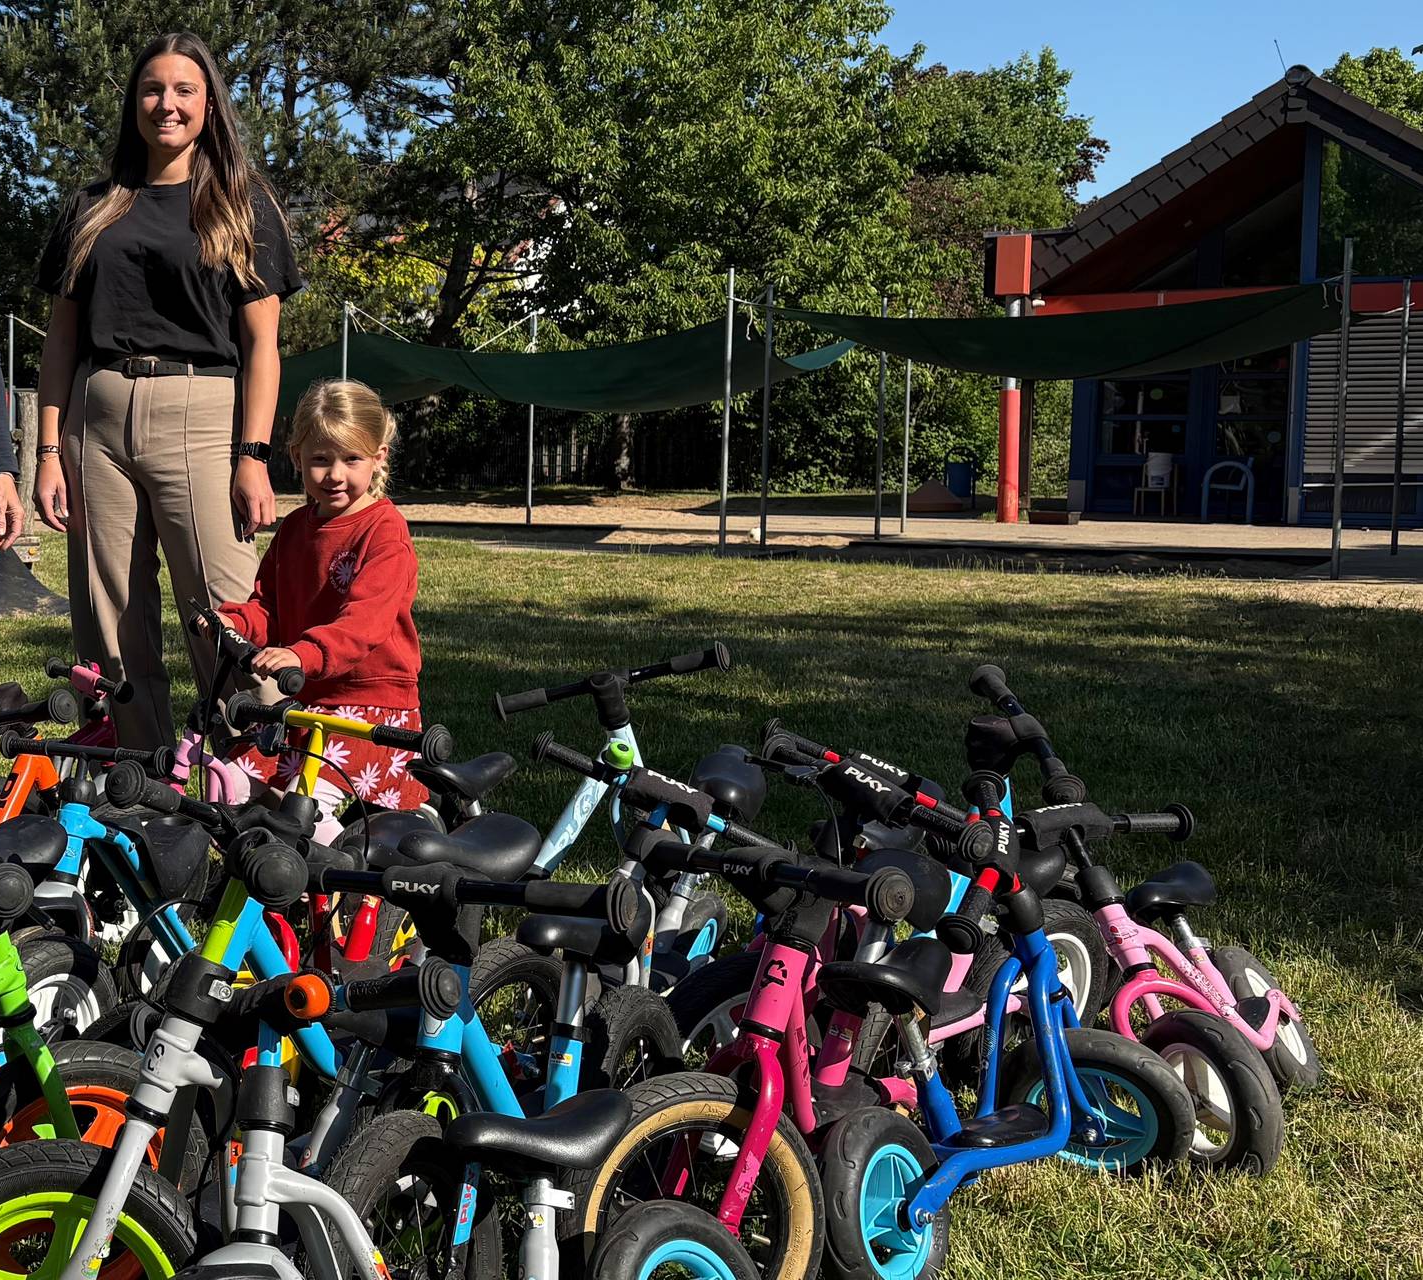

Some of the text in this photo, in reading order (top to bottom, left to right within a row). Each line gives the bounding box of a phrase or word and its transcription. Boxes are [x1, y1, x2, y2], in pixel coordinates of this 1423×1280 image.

[226, 629, 248, 645] PUKY
[859, 753, 908, 777] PUKY
[844, 766, 892, 792] PUKY
[997, 821, 1011, 855] PUKY
[391, 880, 441, 895] PUKY
